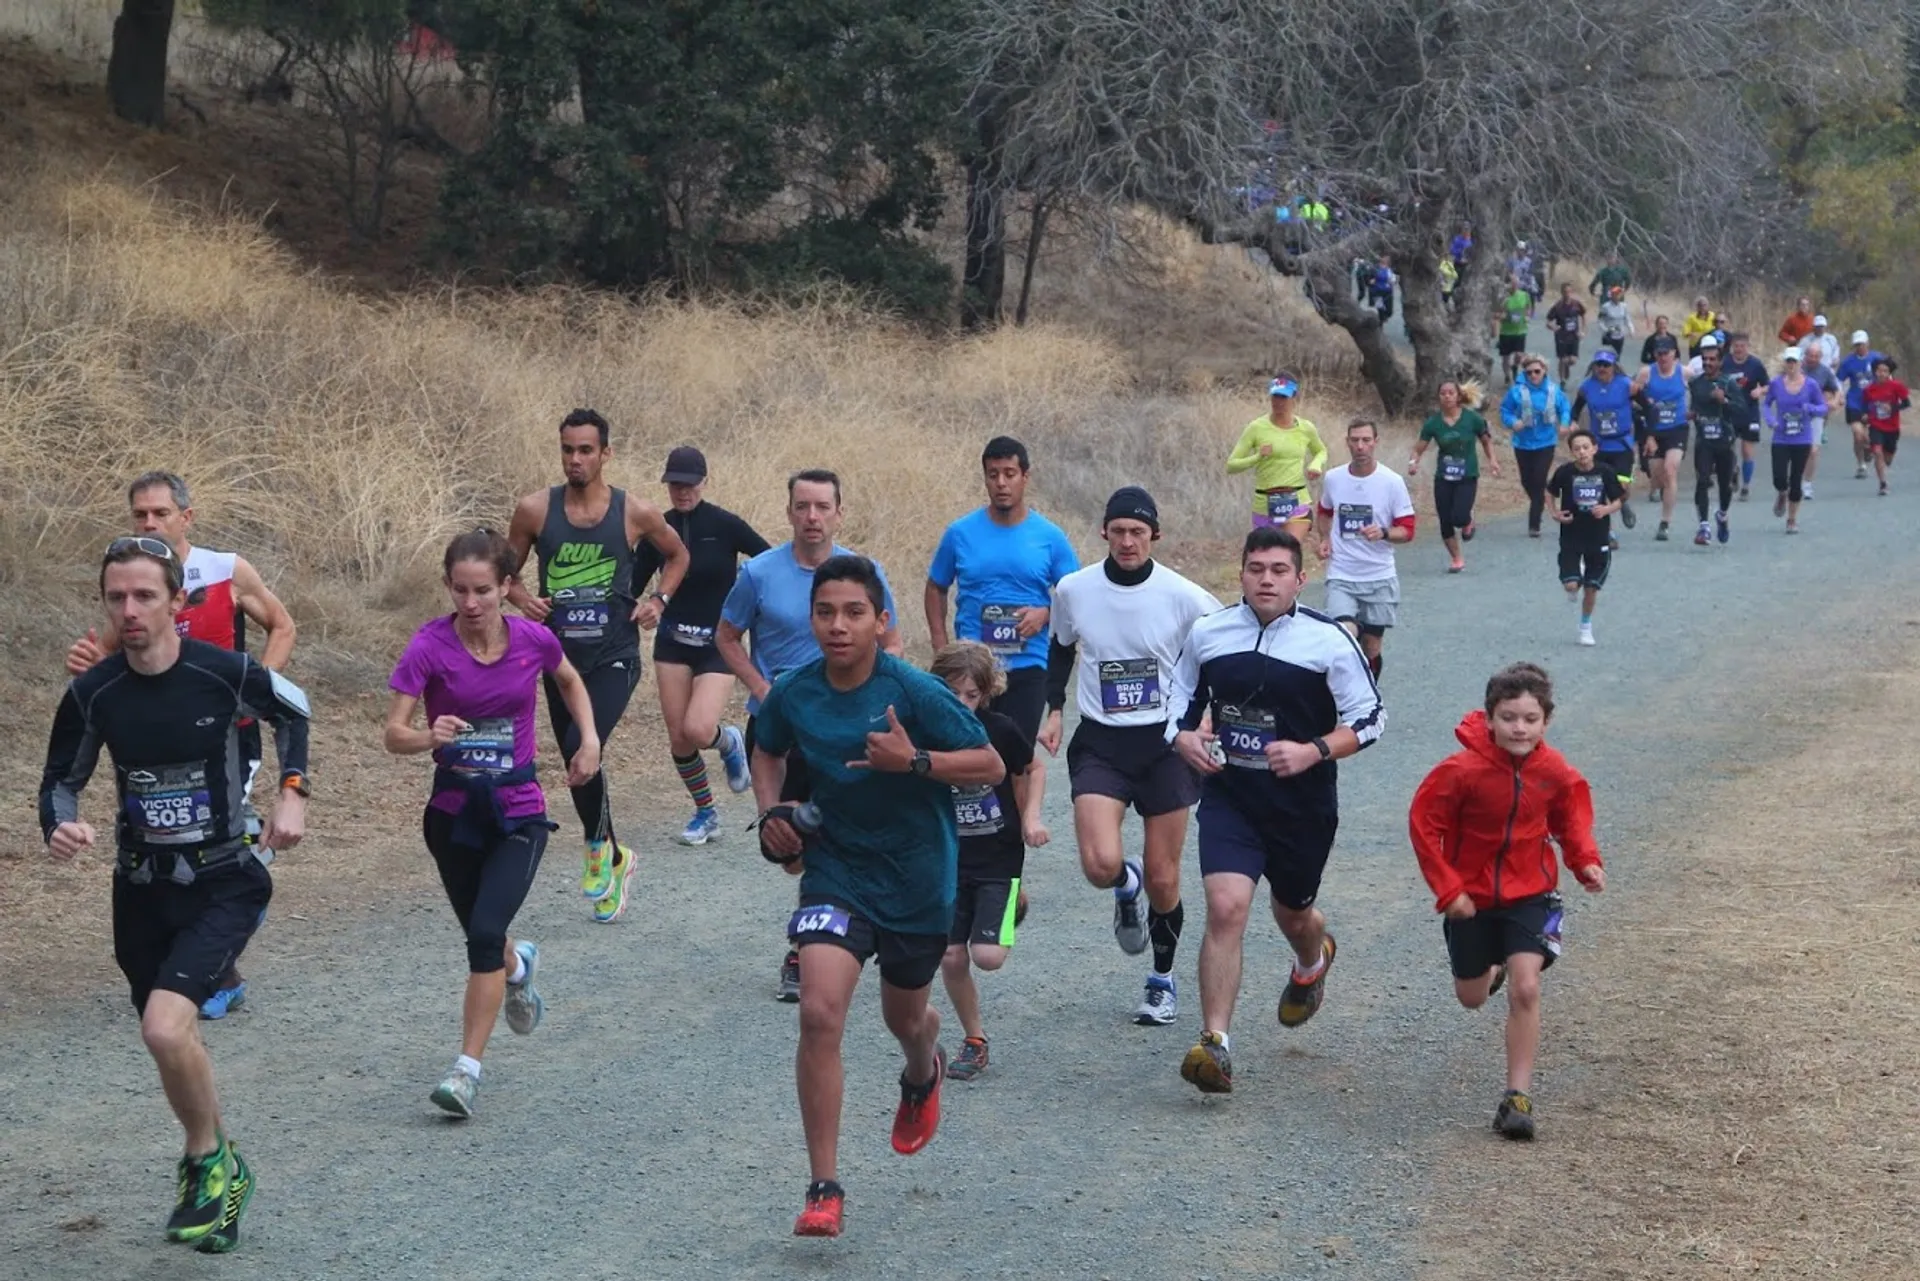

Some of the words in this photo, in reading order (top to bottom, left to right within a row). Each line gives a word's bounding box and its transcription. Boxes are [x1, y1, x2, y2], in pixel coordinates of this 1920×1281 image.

[556, 542, 605, 563] RUN
[567, 608, 596, 622] 692
[993, 626, 1017, 640] 691
[1116, 682, 1144, 693] BRAD
[1117, 691, 1144, 706] 517
[1230, 731, 1262, 750] 706
[460, 749, 498, 762] 703
[139, 796, 193, 811] VICTOR
[955, 802, 982, 811] JACK
[146, 807, 192, 827] 505
[956, 810, 987, 824] 554
